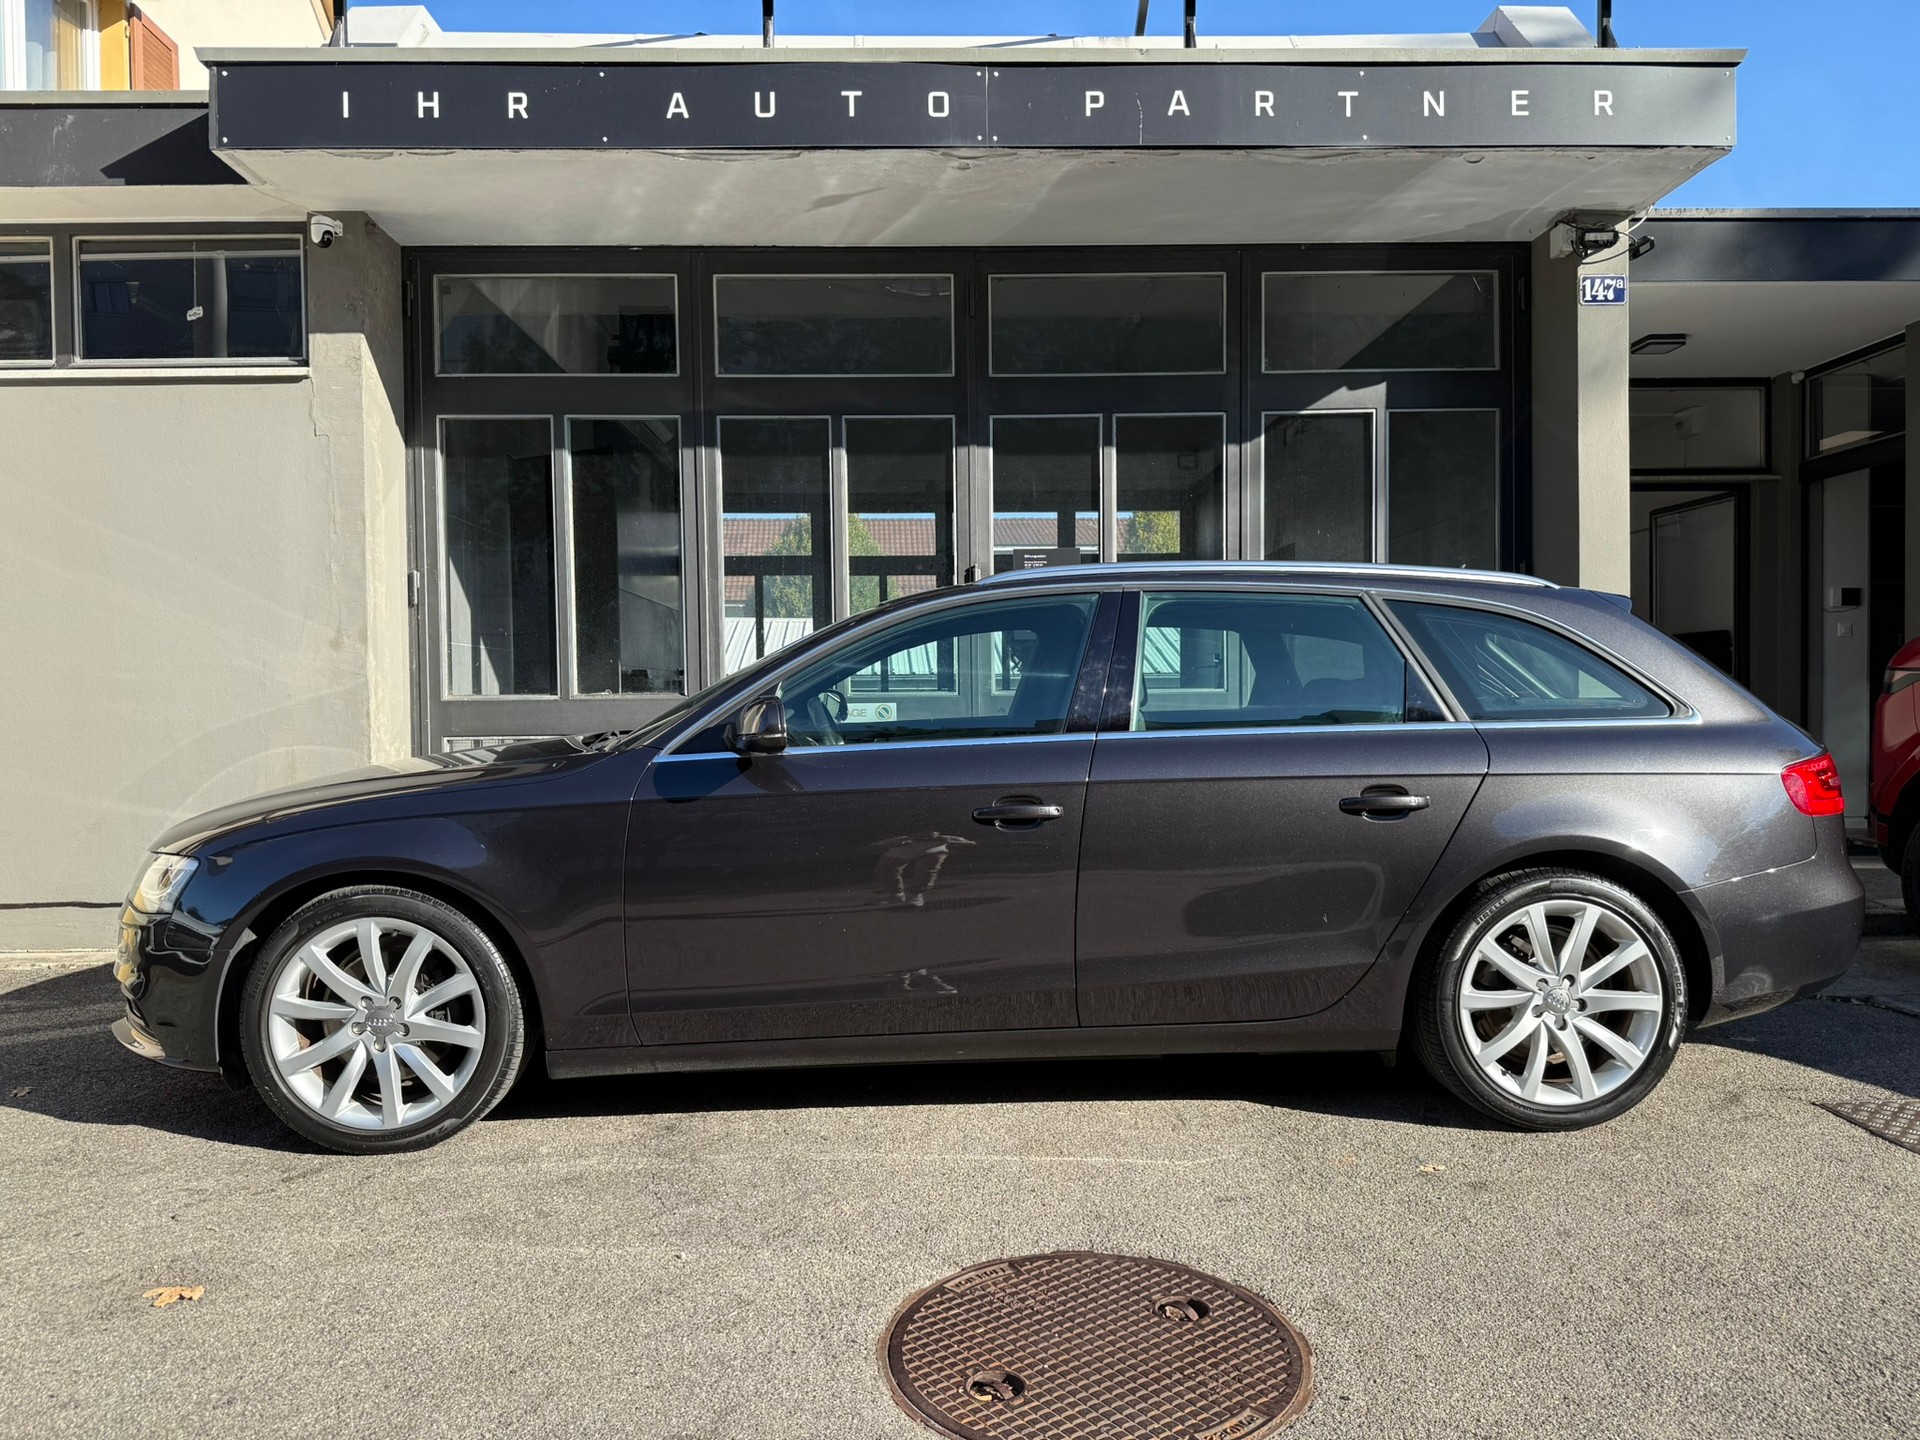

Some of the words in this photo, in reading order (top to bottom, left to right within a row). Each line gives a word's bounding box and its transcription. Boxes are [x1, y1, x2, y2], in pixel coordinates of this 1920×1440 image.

[343, 91, 529, 118] IHR
[665, 90, 950, 118] AUTO
[1085, 90, 1613, 118] PARTNER
[1582, 278, 1624, 301] 147a
